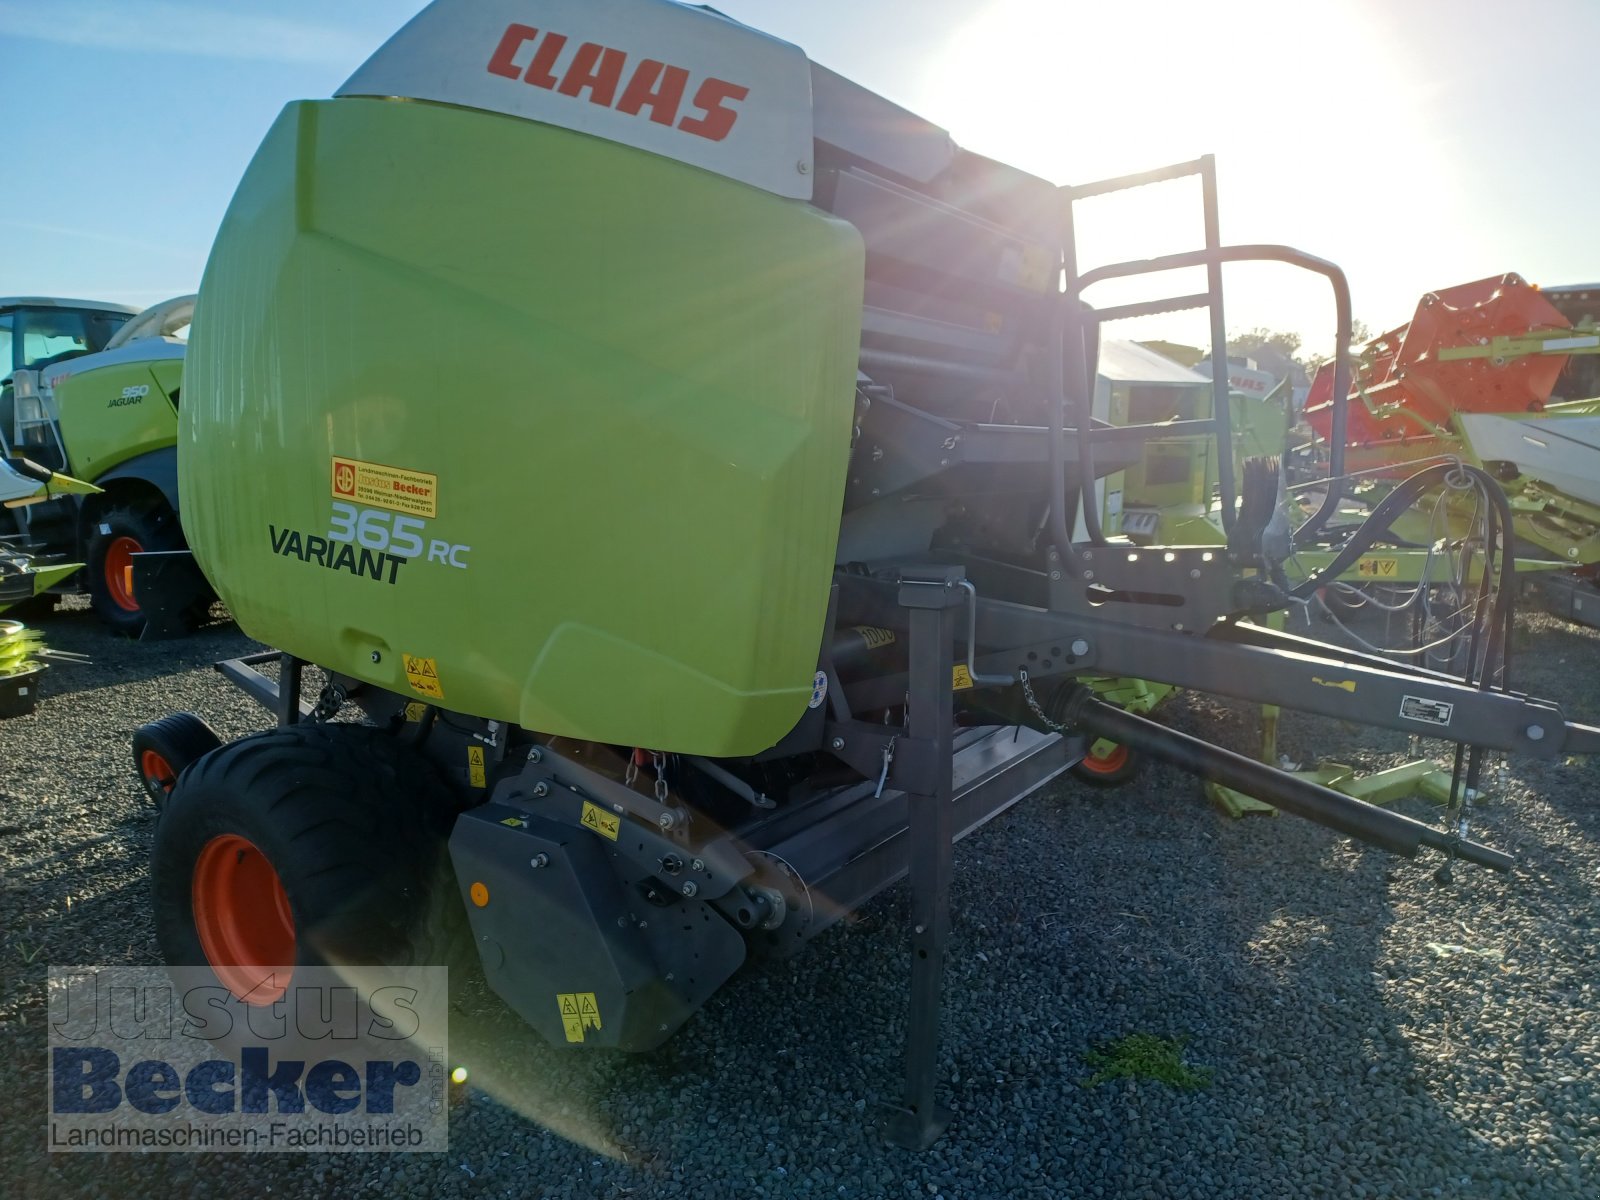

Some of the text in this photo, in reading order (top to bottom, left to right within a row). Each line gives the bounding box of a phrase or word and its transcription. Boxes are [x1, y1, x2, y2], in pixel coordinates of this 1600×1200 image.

[487, 23, 750, 142] CLAAS
[122, 385, 149, 398] 950
[107, 396, 142, 408] JAGUAR
[358, 467, 432, 485] Landmaschinen-Fachbetrieb
[393, 481, 430, 497] Becker
[328, 502, 471, 569] 365 RC
[269, 524, 407, 585] VARIANT
